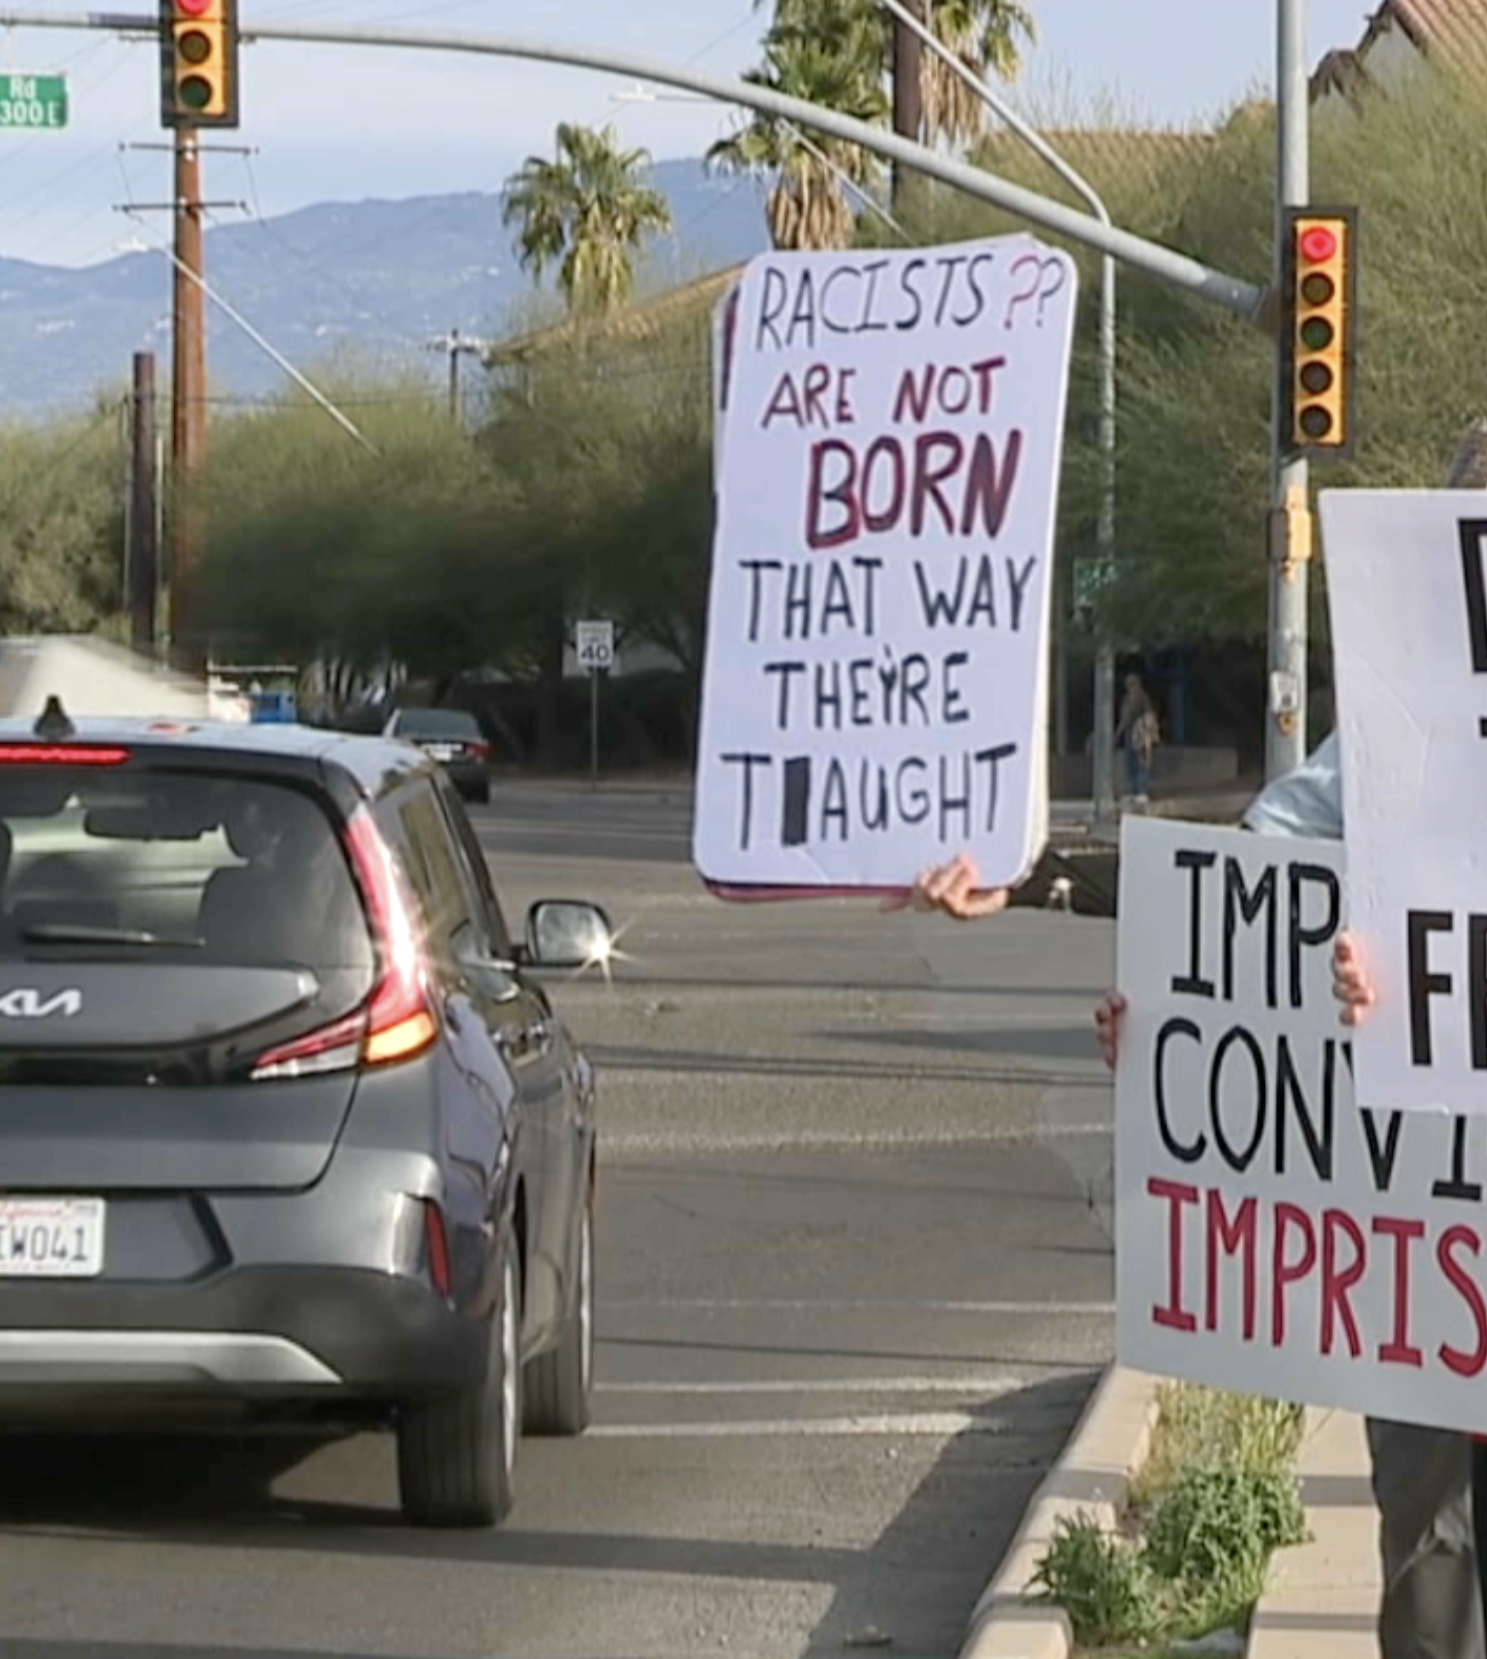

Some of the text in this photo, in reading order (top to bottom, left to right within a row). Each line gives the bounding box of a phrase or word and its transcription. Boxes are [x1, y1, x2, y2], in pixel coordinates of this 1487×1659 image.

[10, 75, 37, 99] Rd
[48, 101, 61, 126] E
[761, 356, 1006, 430] ARE NOT
[805, 428, 1022, 550] BORN
[738, 555, 1037, 642] THAT WAY
[580, 643, 610, 662] 40
